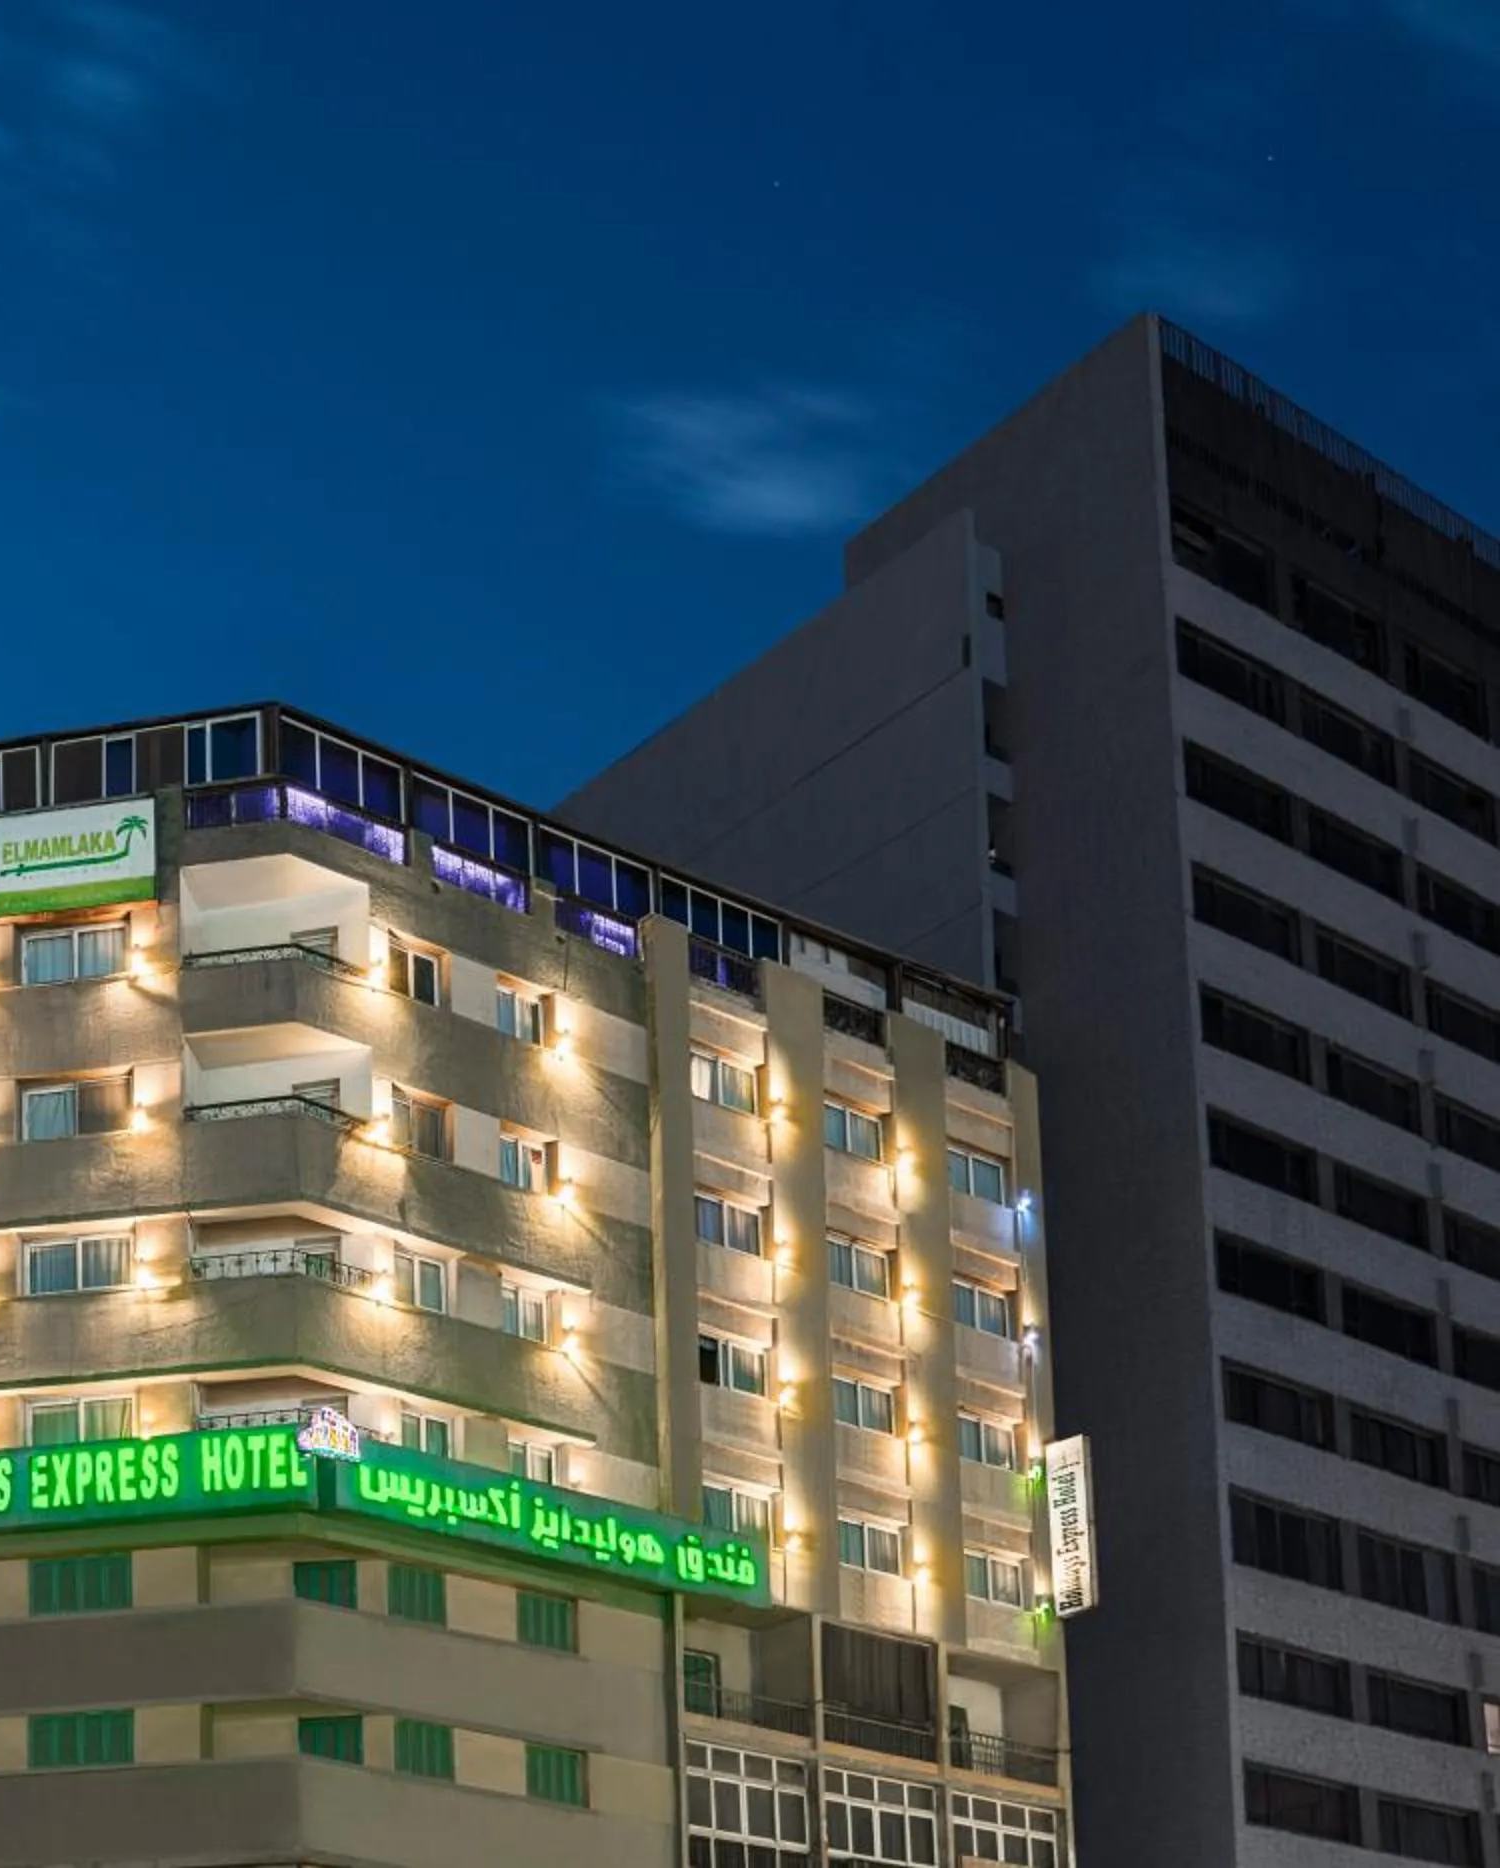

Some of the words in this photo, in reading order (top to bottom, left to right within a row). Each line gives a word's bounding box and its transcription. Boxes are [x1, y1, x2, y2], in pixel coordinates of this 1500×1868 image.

[2, 830, 117, 865] ELMAMLAKA
[31, 1442, 180, 1509] EXPRESS
[201, 1433, 308, 1492] HOTEL
[359, 1462, 521, 1530] أكسبريس
[1052, 1472, 1078, 1510] Hotel
[530, 1497, 665, 1564] هوليدايز
[1057, 1508, 1084, 1556] Express
[676, 1535, 756, 1586] فندق
